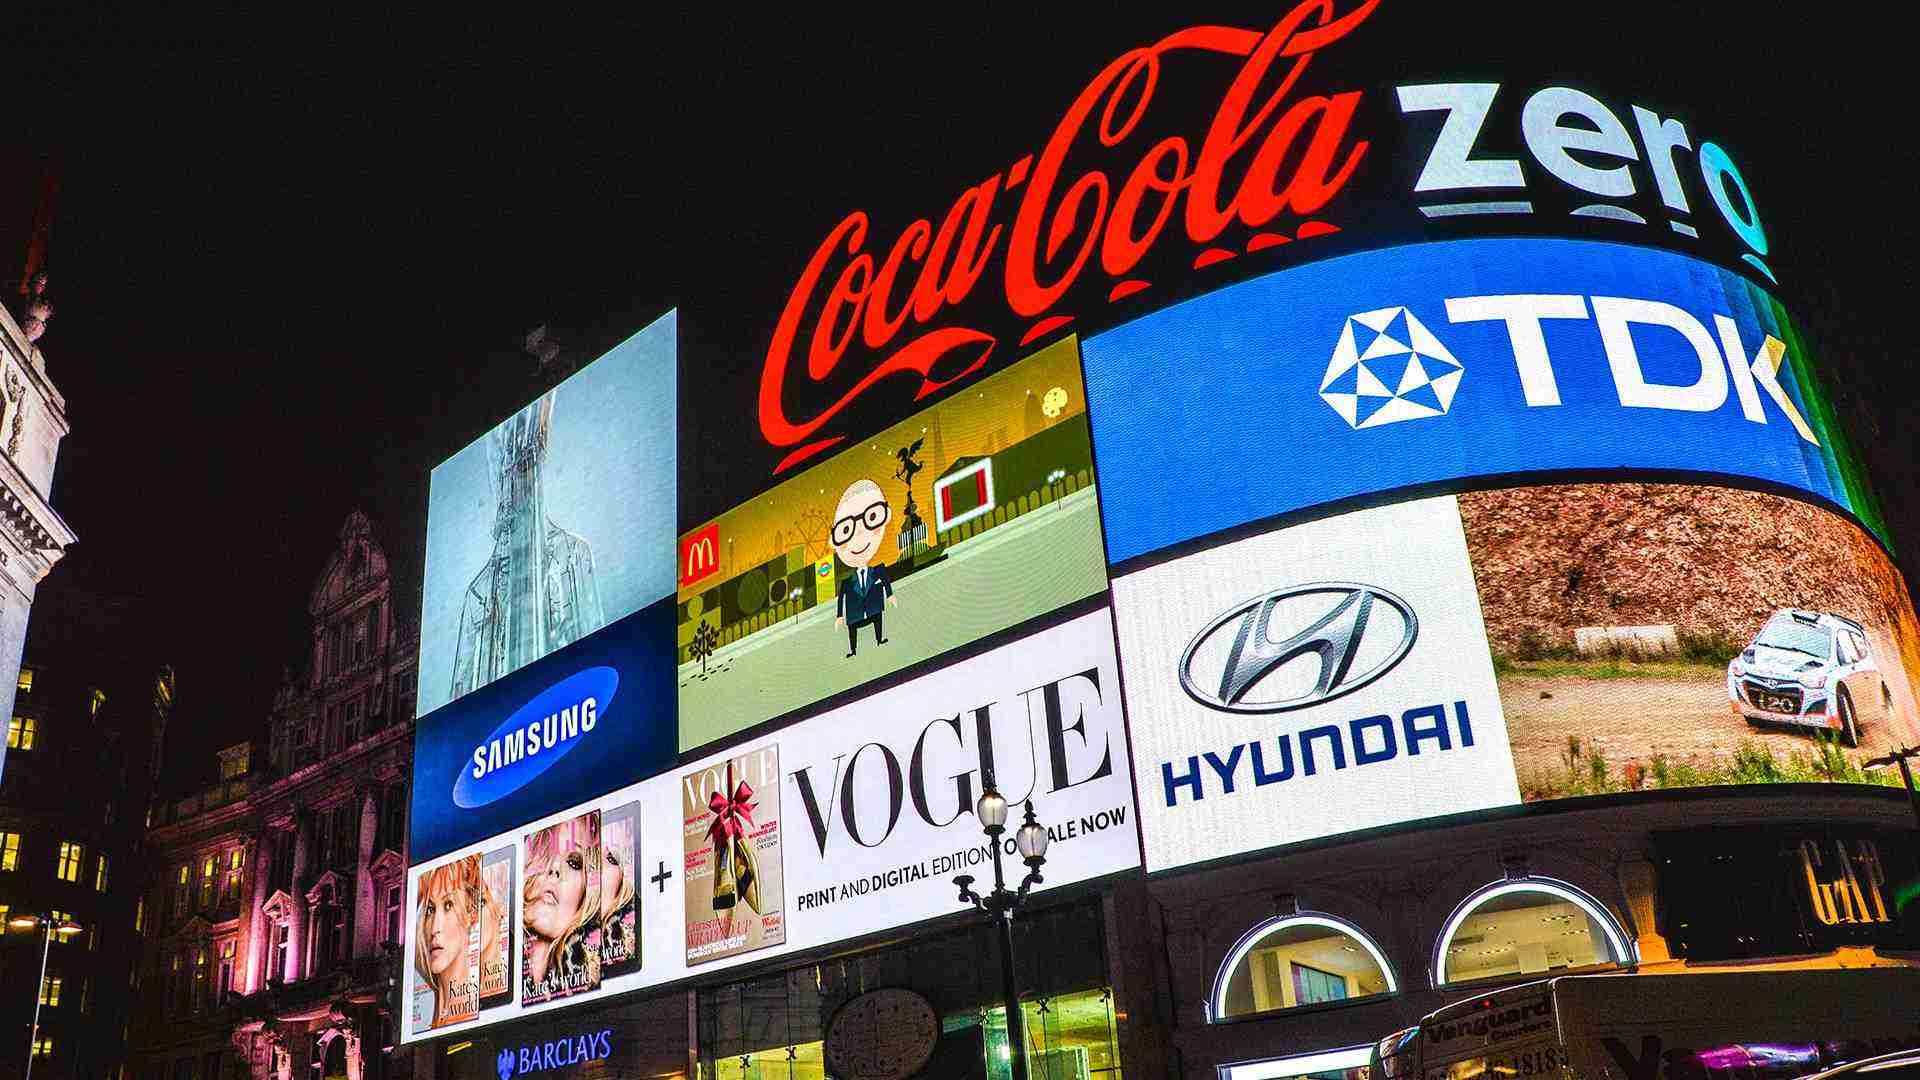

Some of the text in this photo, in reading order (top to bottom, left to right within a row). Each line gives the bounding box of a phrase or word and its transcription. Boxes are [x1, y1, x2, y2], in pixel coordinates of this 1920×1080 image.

[758, 0, 1769, 446] Coca-Cola zero
[1443, 293, 1822, 447] TDK
[472, 697, 598, 779] SAMSUNG
[788, 667, 1113, 860] VOGUE
[1161, 700, 1475, 807] HYUNDAI
[798, 887, 836, 911] PRINT
[840, 878, 869, 900] AND
[872, 862, 929, 892] DIGITAL
[1044, 821, 1077, 844] ALE
[1081, 806, 1126, 835] NOW
[519, 1028, 615, 1074] BARCLAYS
